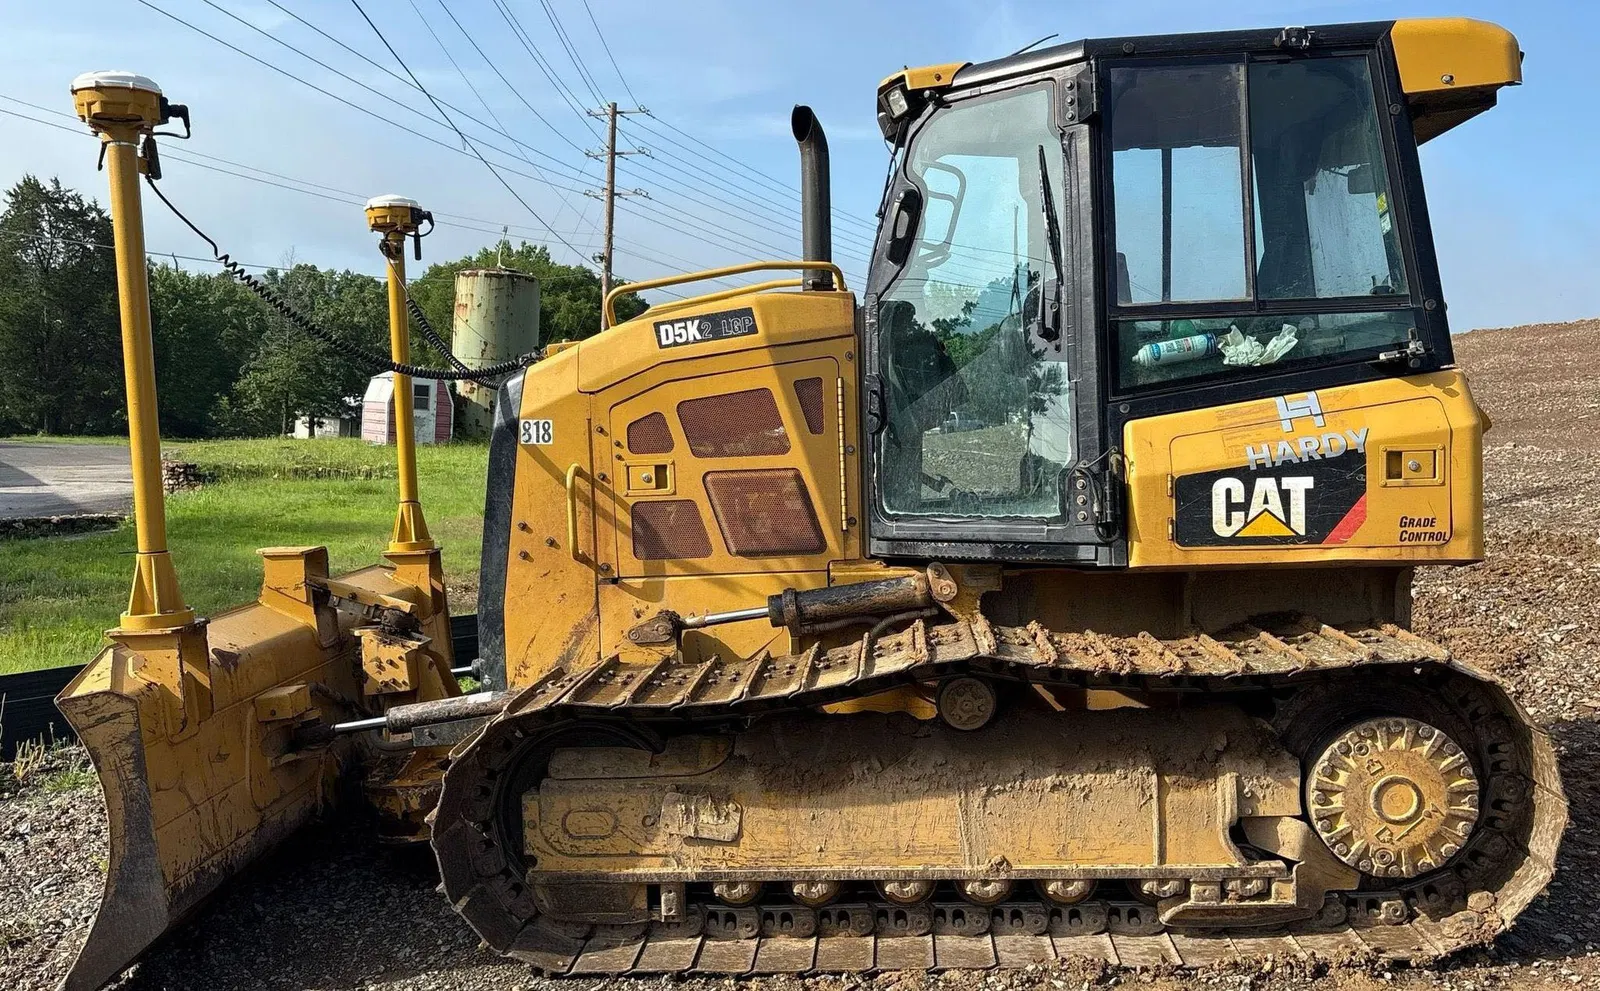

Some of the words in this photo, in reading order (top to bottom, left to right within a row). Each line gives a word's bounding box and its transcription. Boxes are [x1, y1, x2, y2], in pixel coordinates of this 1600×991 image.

[721, 316, 753, 336] LGP
[522, 420, 552, 443] 818
[1246, 428, 1369, 471] HARDY
[1212, 477, 1314, 537] CAT
